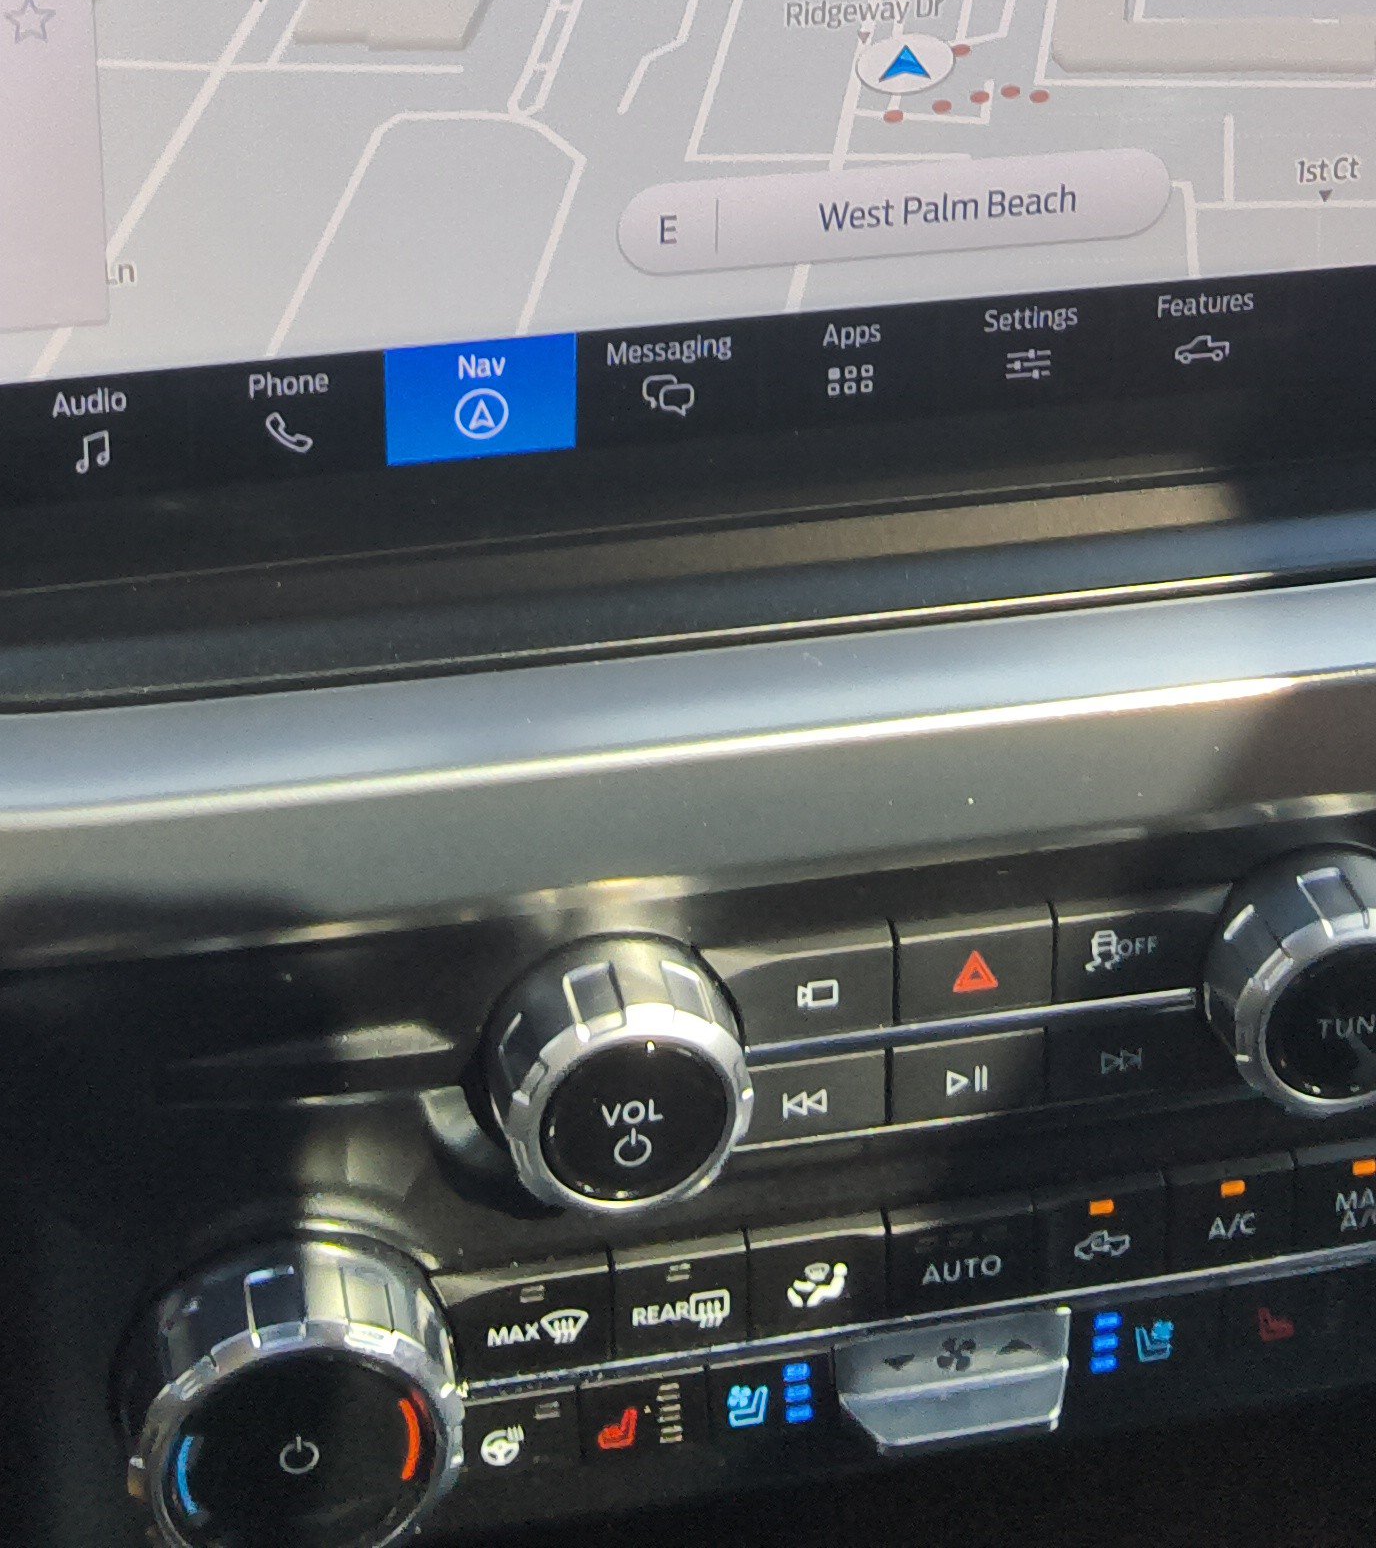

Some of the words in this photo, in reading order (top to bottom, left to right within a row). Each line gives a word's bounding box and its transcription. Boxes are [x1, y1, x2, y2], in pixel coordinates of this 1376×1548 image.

[785, 0, 908, 29] Ridgeway
[1297, 161, 1323, 183] 1st
[1328, 158, 1360, 180] Ct
[819, 201, 895, 232] West
[903, 194, 978, 226] Palm
[988, 185, 1077, 219] Beach
[660, 216, 677, 244] E
[1157, 291, 1254, 319] Features
[985, 305, 1078, 334] Settings
[824, 322, 881, 350] Apps
[607, 335, 732, 366] Messaging
[458, 354, 506, 379] Nav
[248, 370, 329, 400] Phone
[53, 389, 126, 418] Audio
[1118, 934, 1158, 956] OFF
[602, 1099, 663, 1127] VOL
[1209, 1212, 1256, 1239] A/C
[923, 1255, 1001, 1284] AUTO
[632, 1301, 688, 1327] REAR
[488, 1323, 541, 1347] MAX
